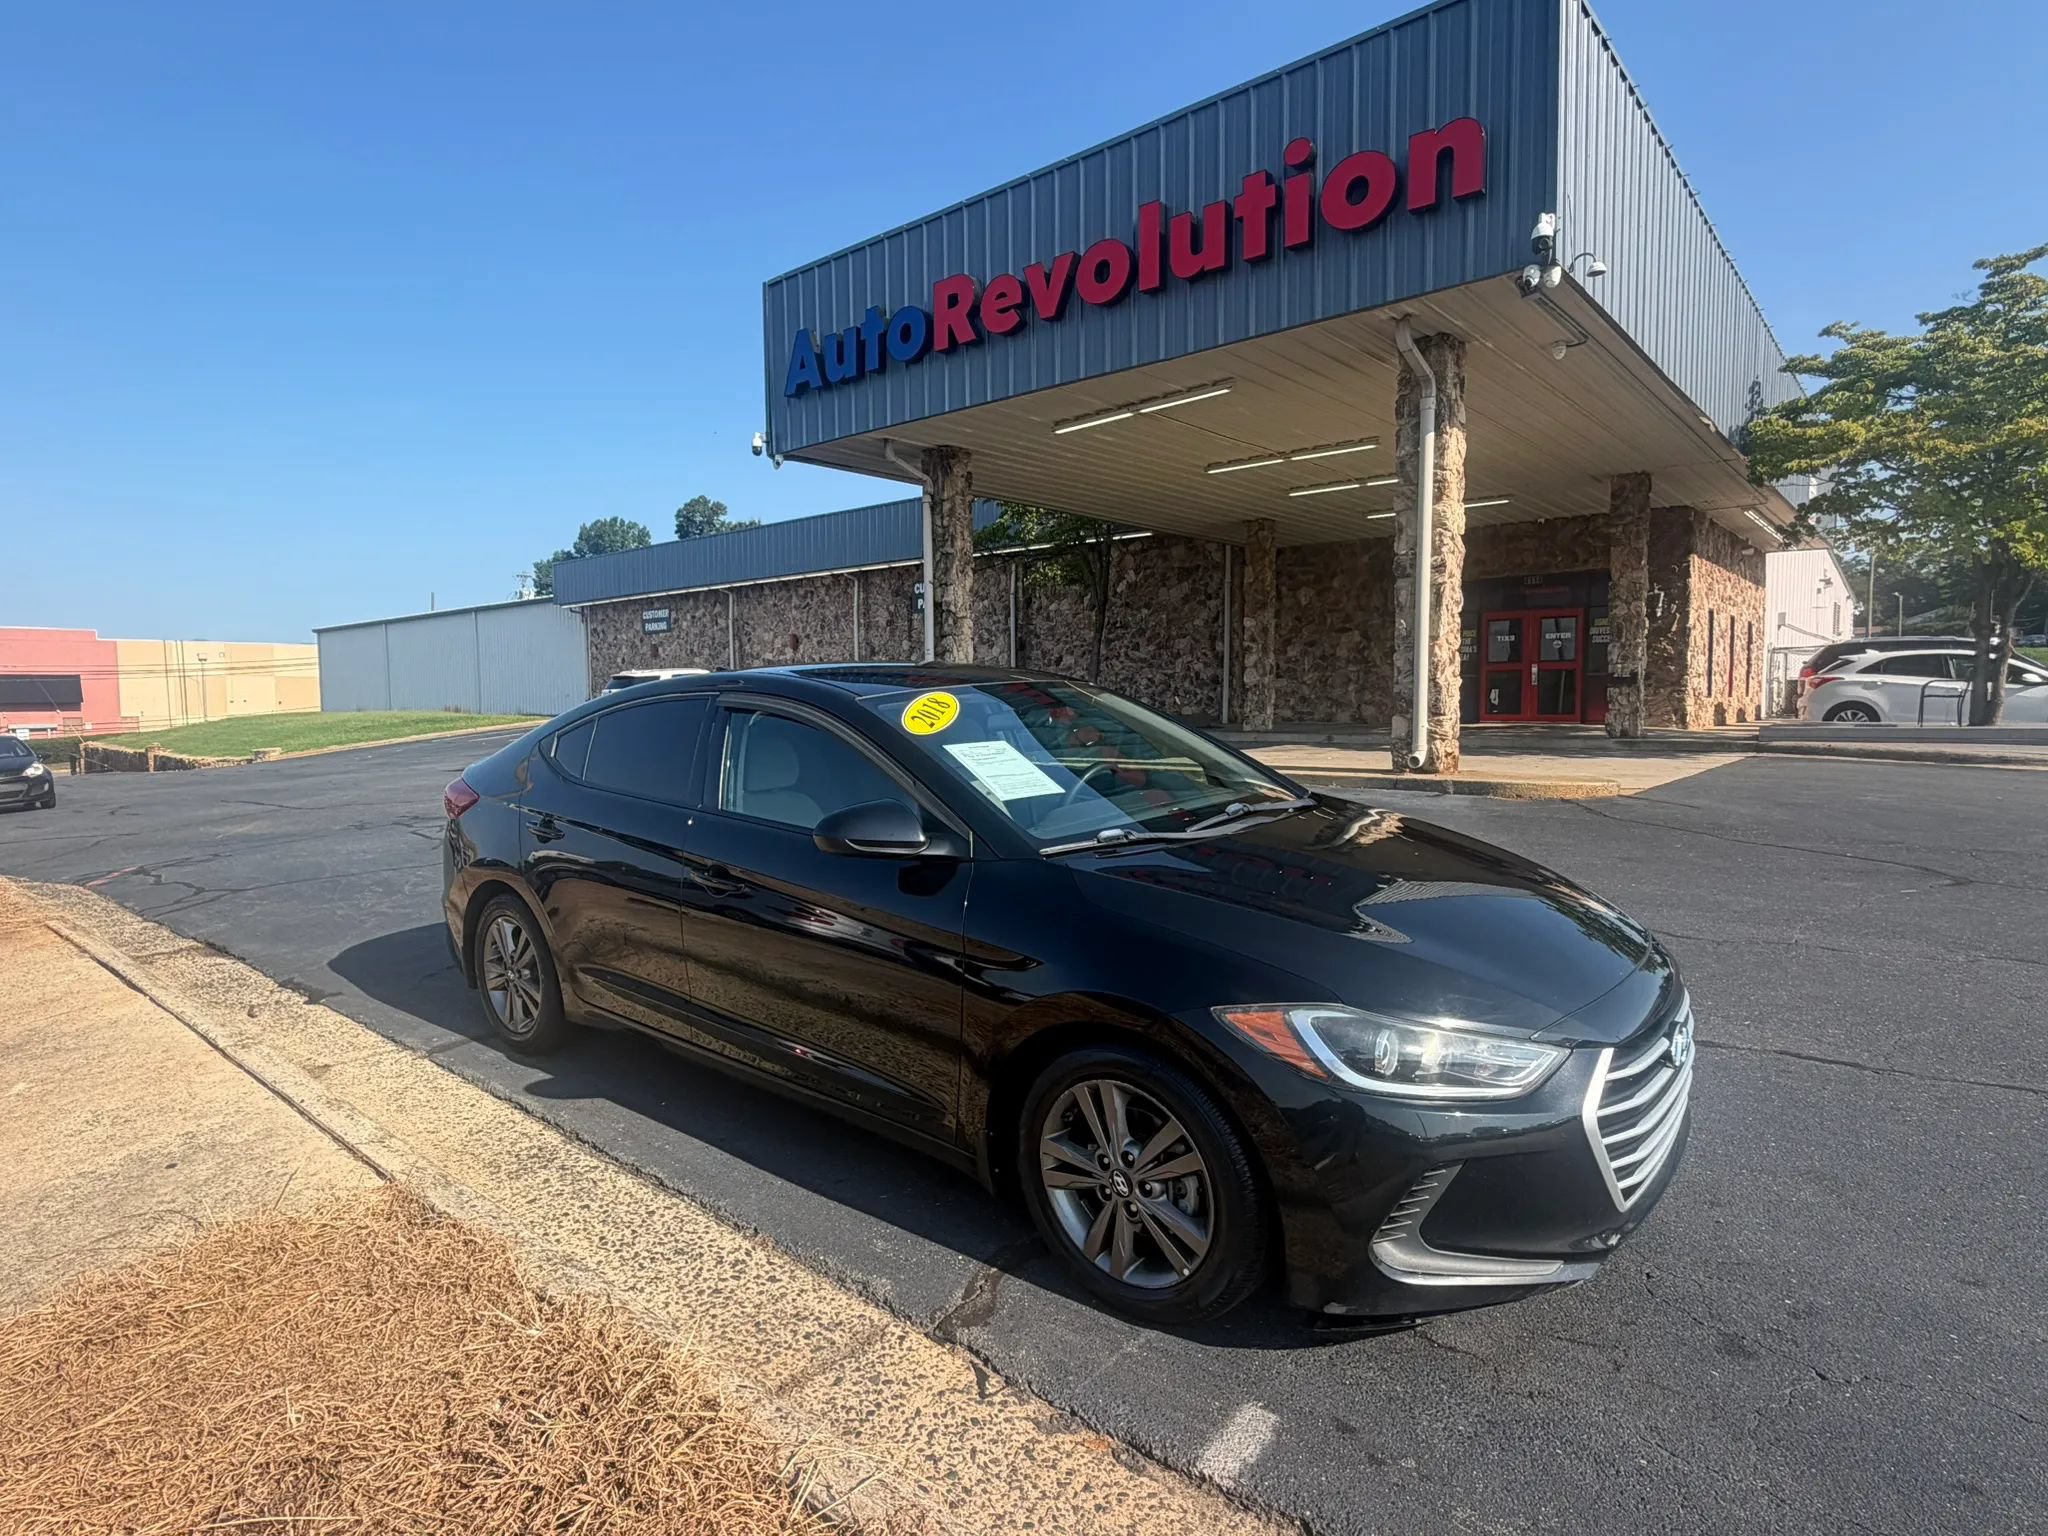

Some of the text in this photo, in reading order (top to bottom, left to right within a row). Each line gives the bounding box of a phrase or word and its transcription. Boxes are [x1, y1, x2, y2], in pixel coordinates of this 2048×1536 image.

[785, 116, 1486, 398] AutoRevolution
[643, 608, 669, 619] CUSTOMER
[645, 621, 667, 632] PARKING
[910, 697, 951, 728] 2018
